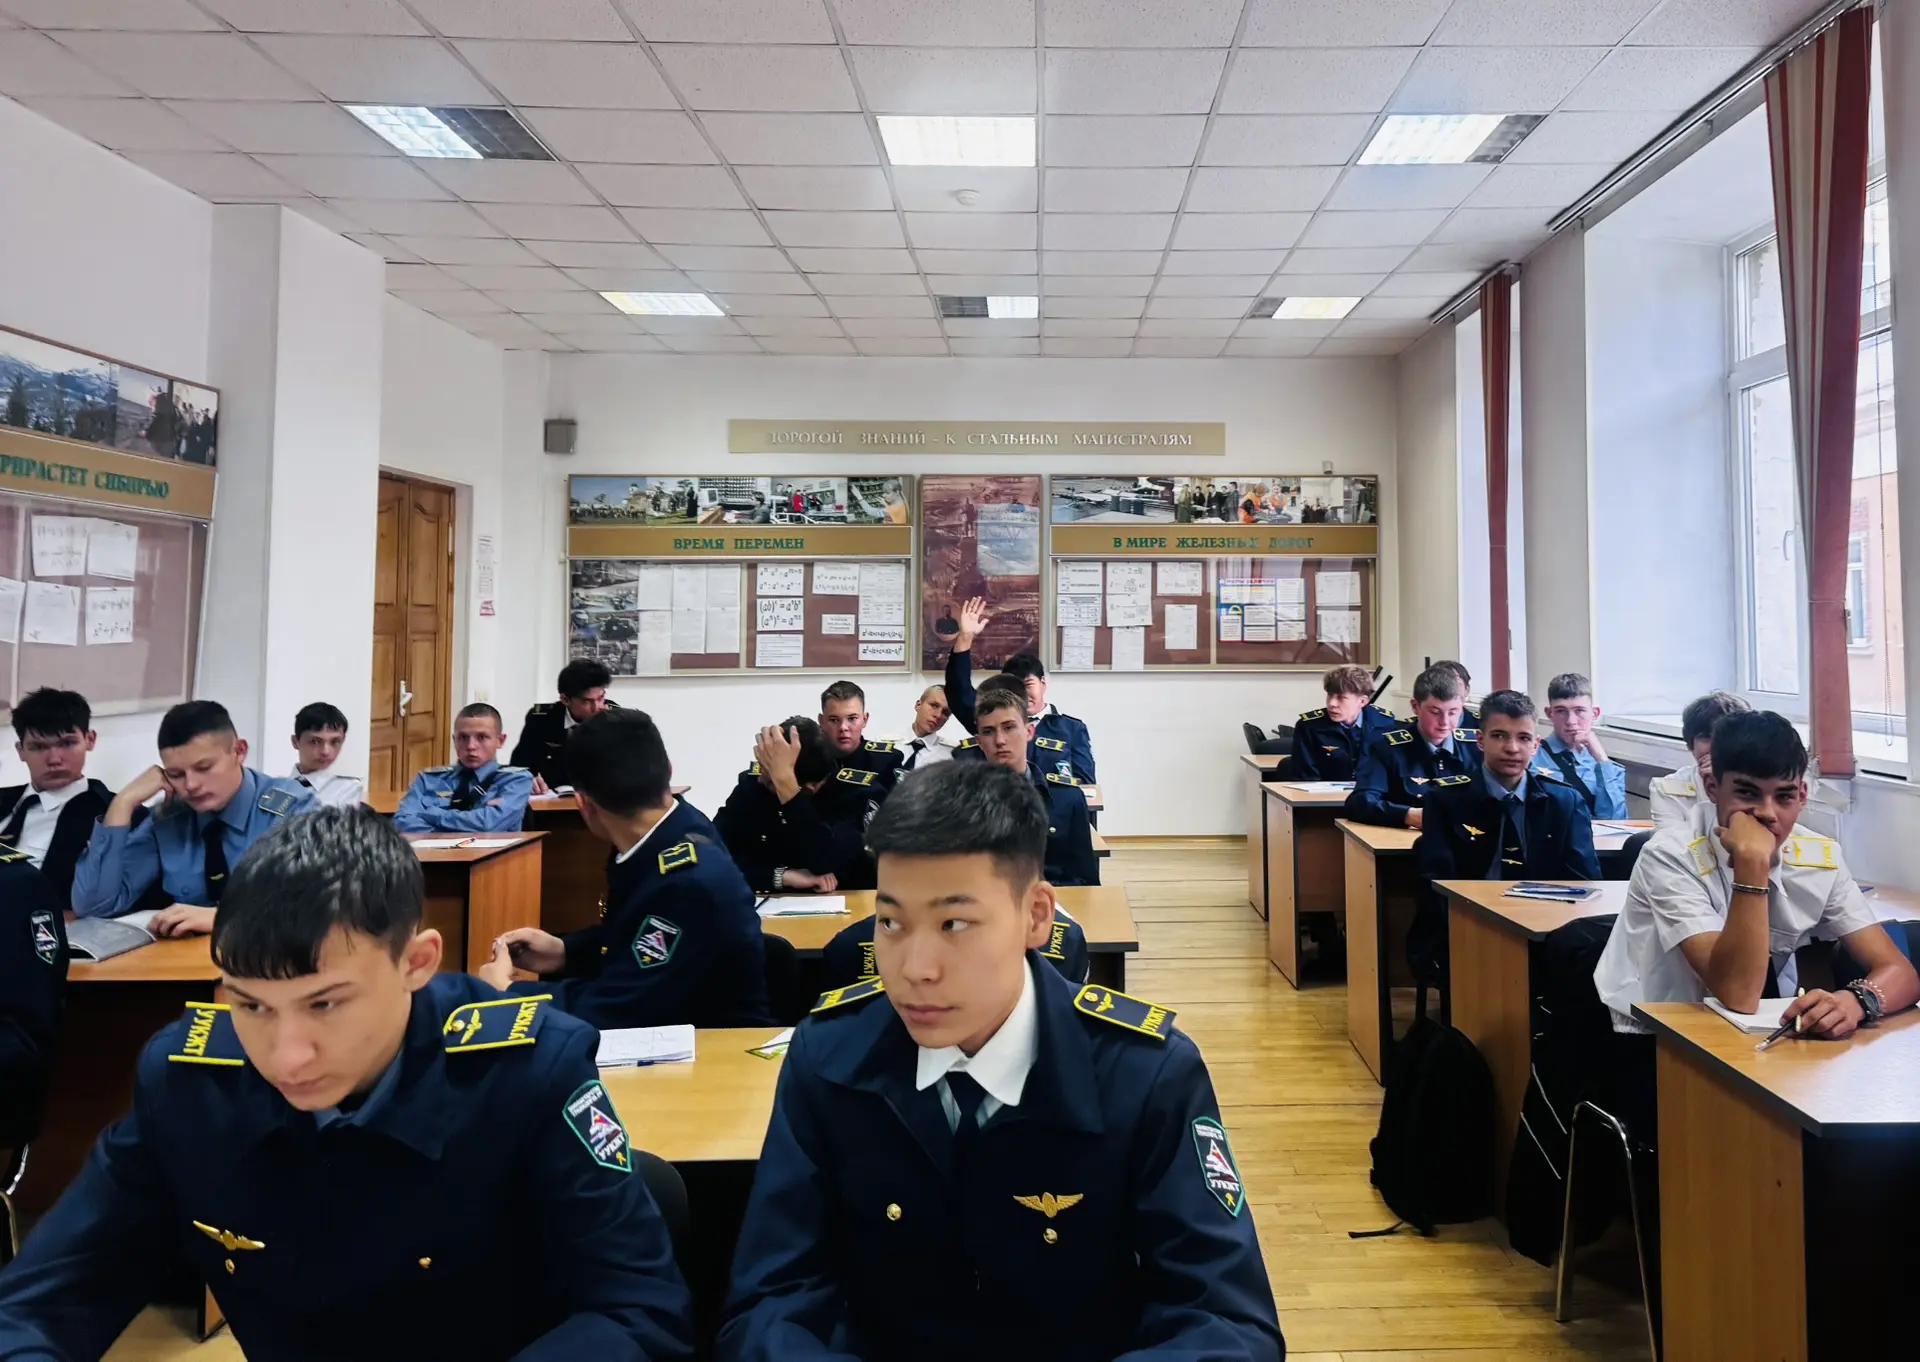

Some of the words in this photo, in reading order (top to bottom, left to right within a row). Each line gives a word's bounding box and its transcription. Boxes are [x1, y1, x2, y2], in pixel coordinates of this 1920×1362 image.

[860, 429, 926, 445] ЗНАНИЙ
[946, 432, 956, 445] К
[967, 432, 1059, 446] СТАЛЬНЫМ
[1073, 432, 1193, 446] МАГИСТРАЛЯМ
[673, 538, 725, 550] ВРЕМЯ
[734, 538, 805, 550] ПЕРЕМЕН
[1113, 537, 1122, 548] В
[1126, 537, 1167, 548] МИРЕ
[1176, 537, 1260, 549] ЖЕЛЕЗНЫХ
[1268, 537, 1315, 550] ДОРОГ
[507, 1002, 539, 1041] УУКЖТ
[183, 1008, 217, 1056] УУКЖТ
